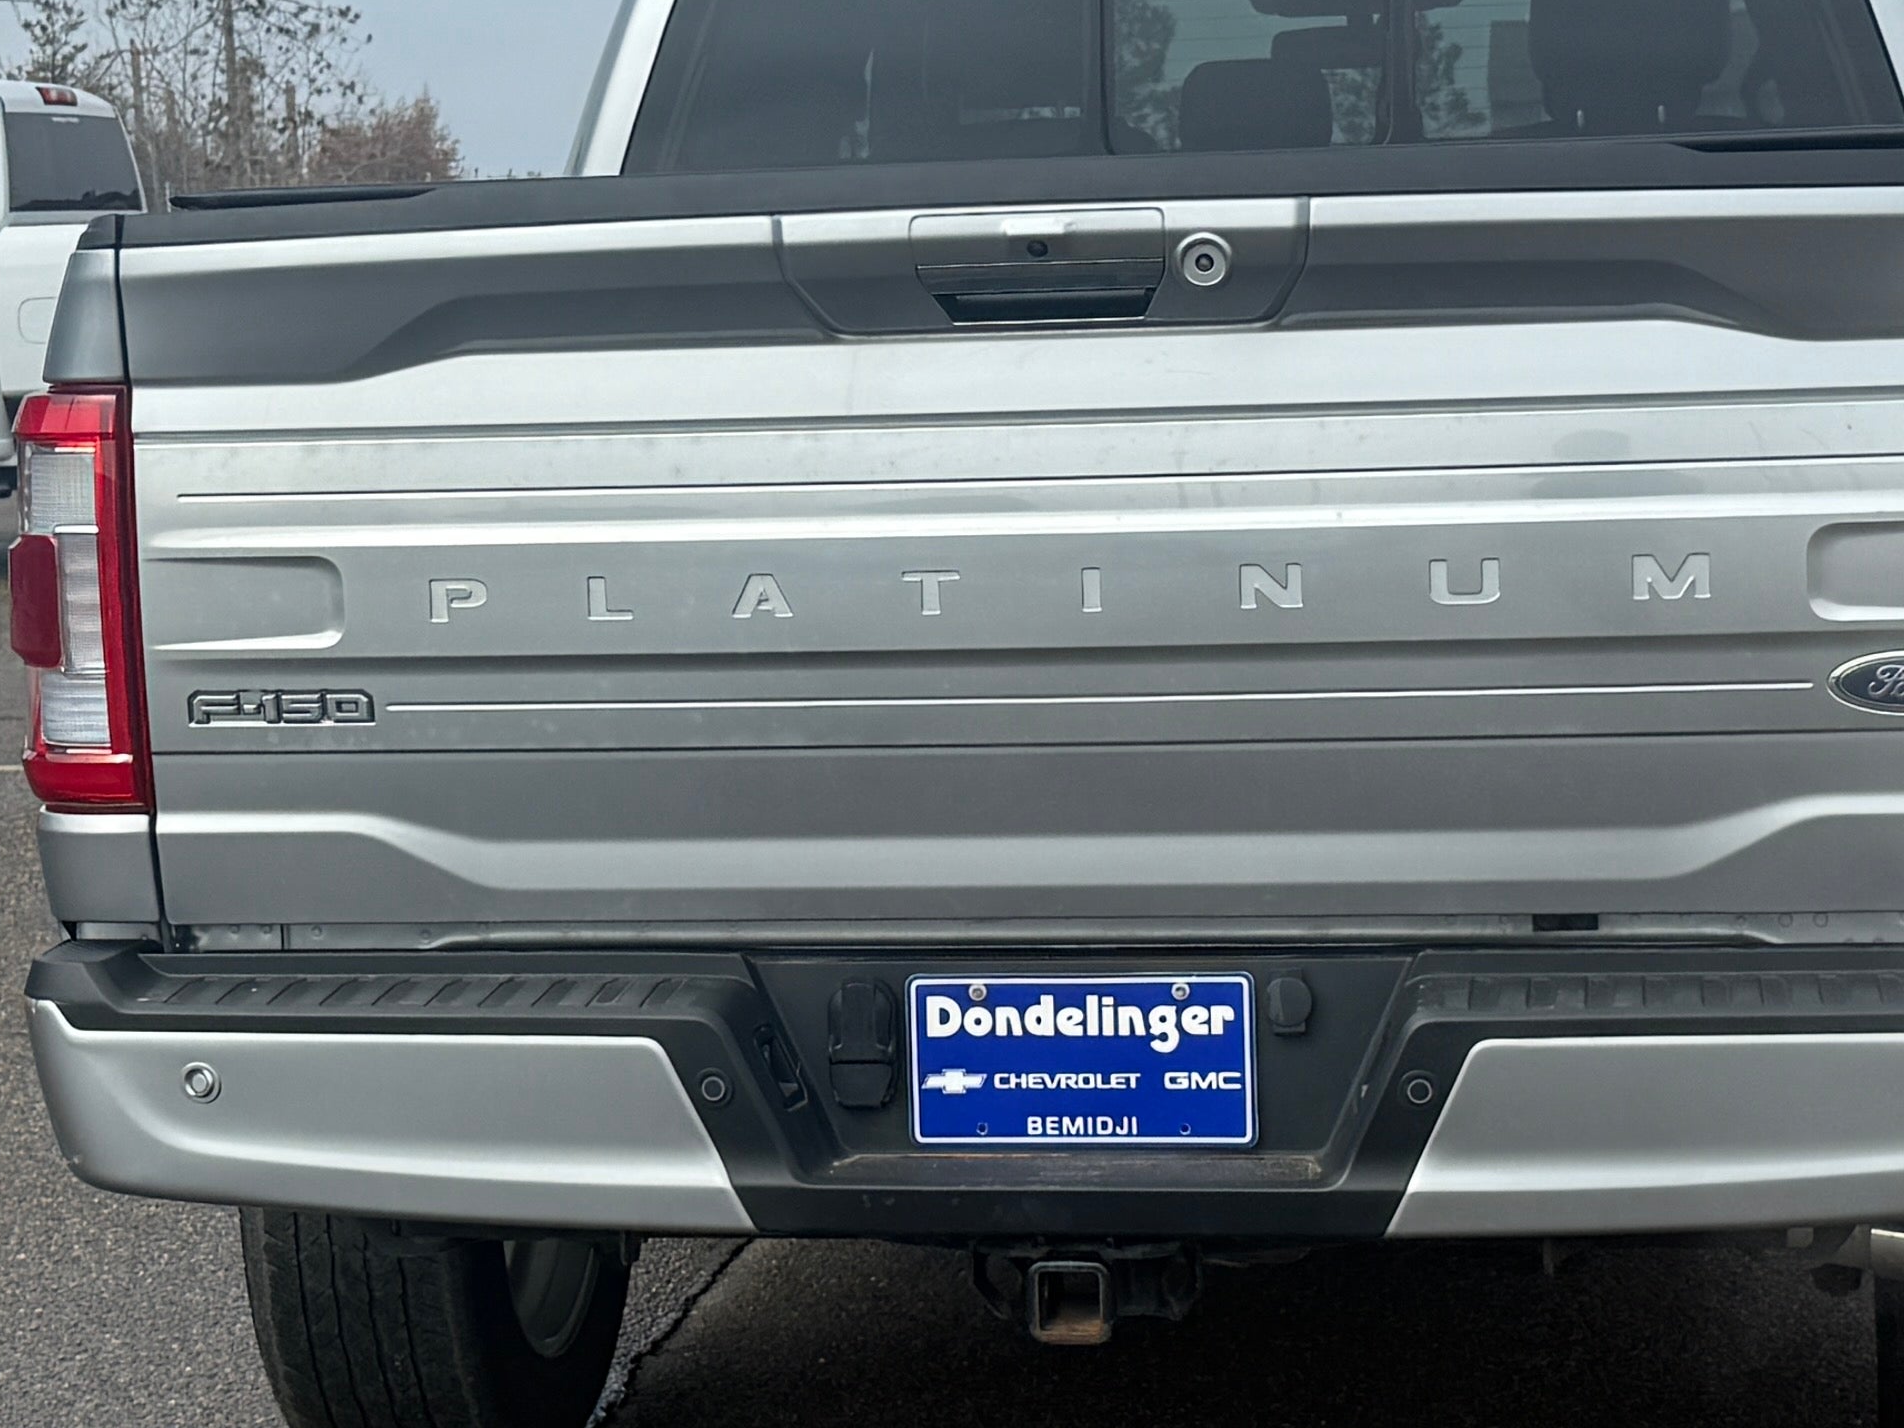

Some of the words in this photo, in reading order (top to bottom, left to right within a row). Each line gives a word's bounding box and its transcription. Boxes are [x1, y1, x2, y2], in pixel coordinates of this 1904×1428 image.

[428, 551, 1712, 624] PLATINUM
[188, 689, 376, 727] F-150
[925, 994, 1236, 1054] Dondelinger
[993, 1072, 1142, 1091] CHEVROLET
[1163, 1071, 1242, 1091] GMC
[1027, 1115, 1138, 1136] BEMIDJI
